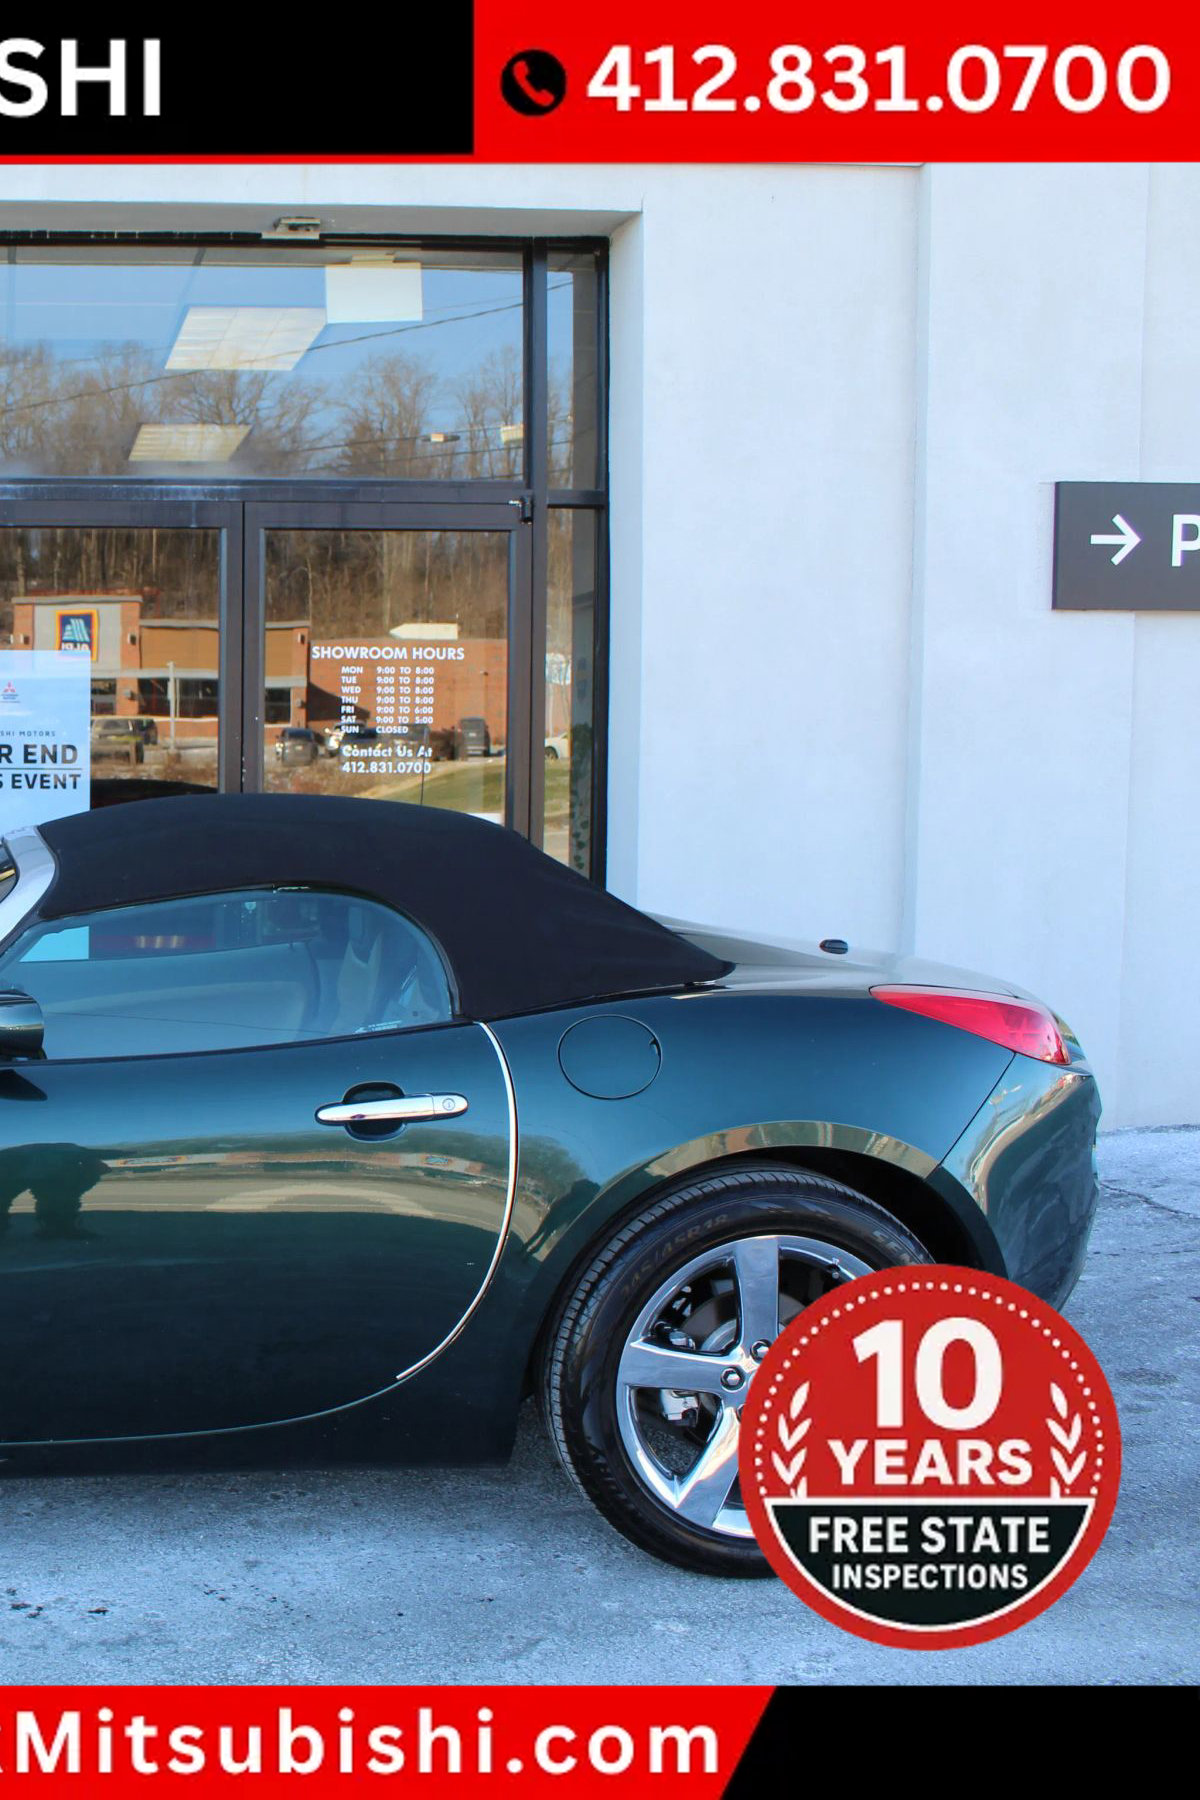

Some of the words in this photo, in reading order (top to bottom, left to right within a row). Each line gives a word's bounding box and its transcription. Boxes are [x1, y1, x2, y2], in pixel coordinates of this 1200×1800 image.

[311, 646, 408, 660] SHOWROOM
[412, 647, 465, 660] HOURS
[341, 676, 357, 684] TUE
[399, 676, 411, 684] TO
[341, 686, 361, 694] WED
[399, 686, 411, 694] TO
[341, 696, 359, 704] THU
[399, 696, 411, 704] TO
[341, 706, 354, 714] FRI
[399, 706, 410, 714] TO
[341, 716, 356, 724] SAT
[398, 716, 409, 724] TO
[18, 730, 56, 738] MOTORS
[341, 726, 360, 734] SUN
[376, 726, 409, 734] CLOSED
[22, 743, 79, 765] END
[342, 745, 392, 758] Contact
[396, 745, 413, 758] Us
[341, 762, 431, 774] 412.831.0700
[10, 773, 82, 790] EVENT
